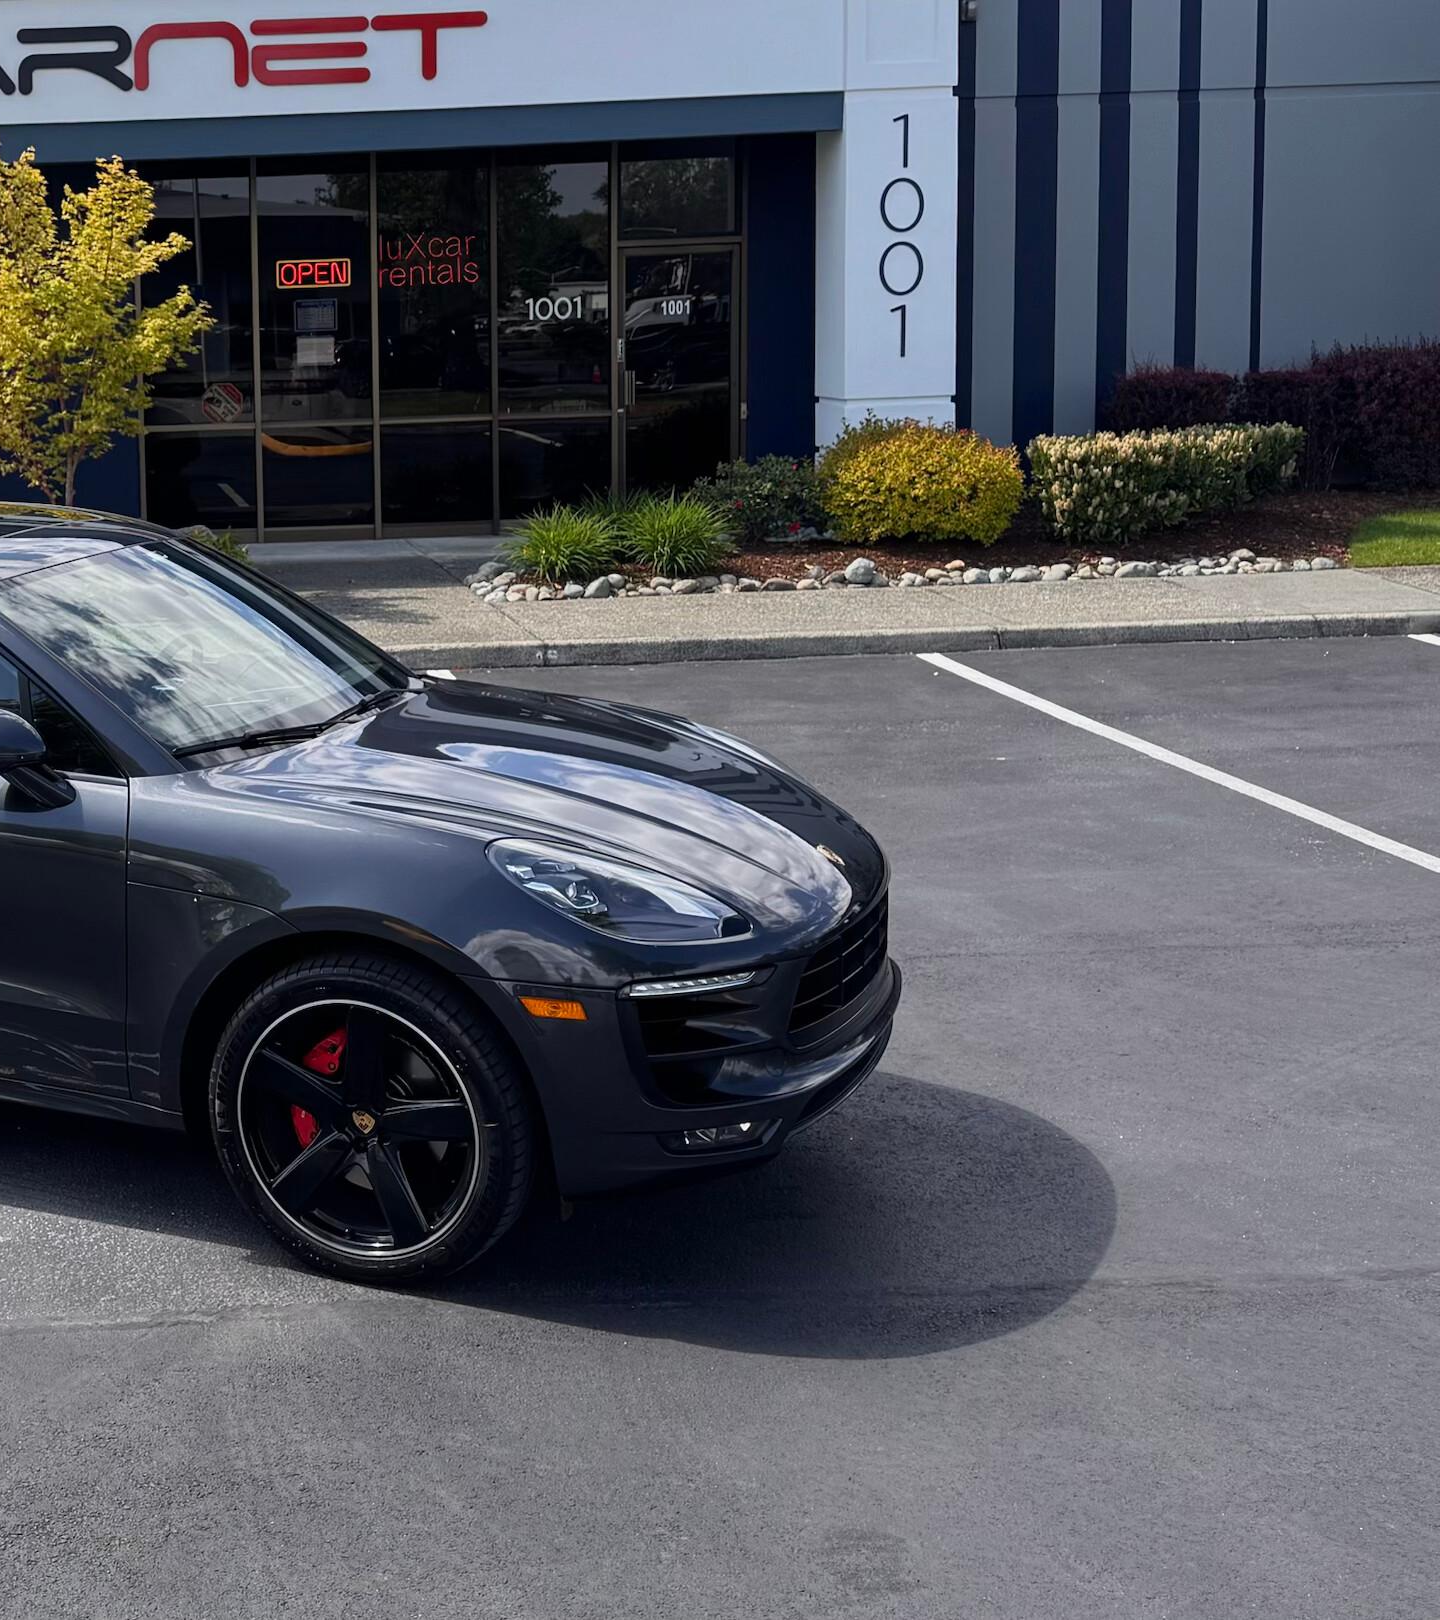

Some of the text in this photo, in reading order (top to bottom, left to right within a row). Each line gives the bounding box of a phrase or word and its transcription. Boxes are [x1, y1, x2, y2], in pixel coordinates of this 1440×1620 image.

[879, 113, 924, 358] 1001
[280, 261, 347, 286] OPEN
[378, 257, 479, 288] rentals
[524, 296, 582, 321] 1001
[661, 299, 690, 316] 1001
